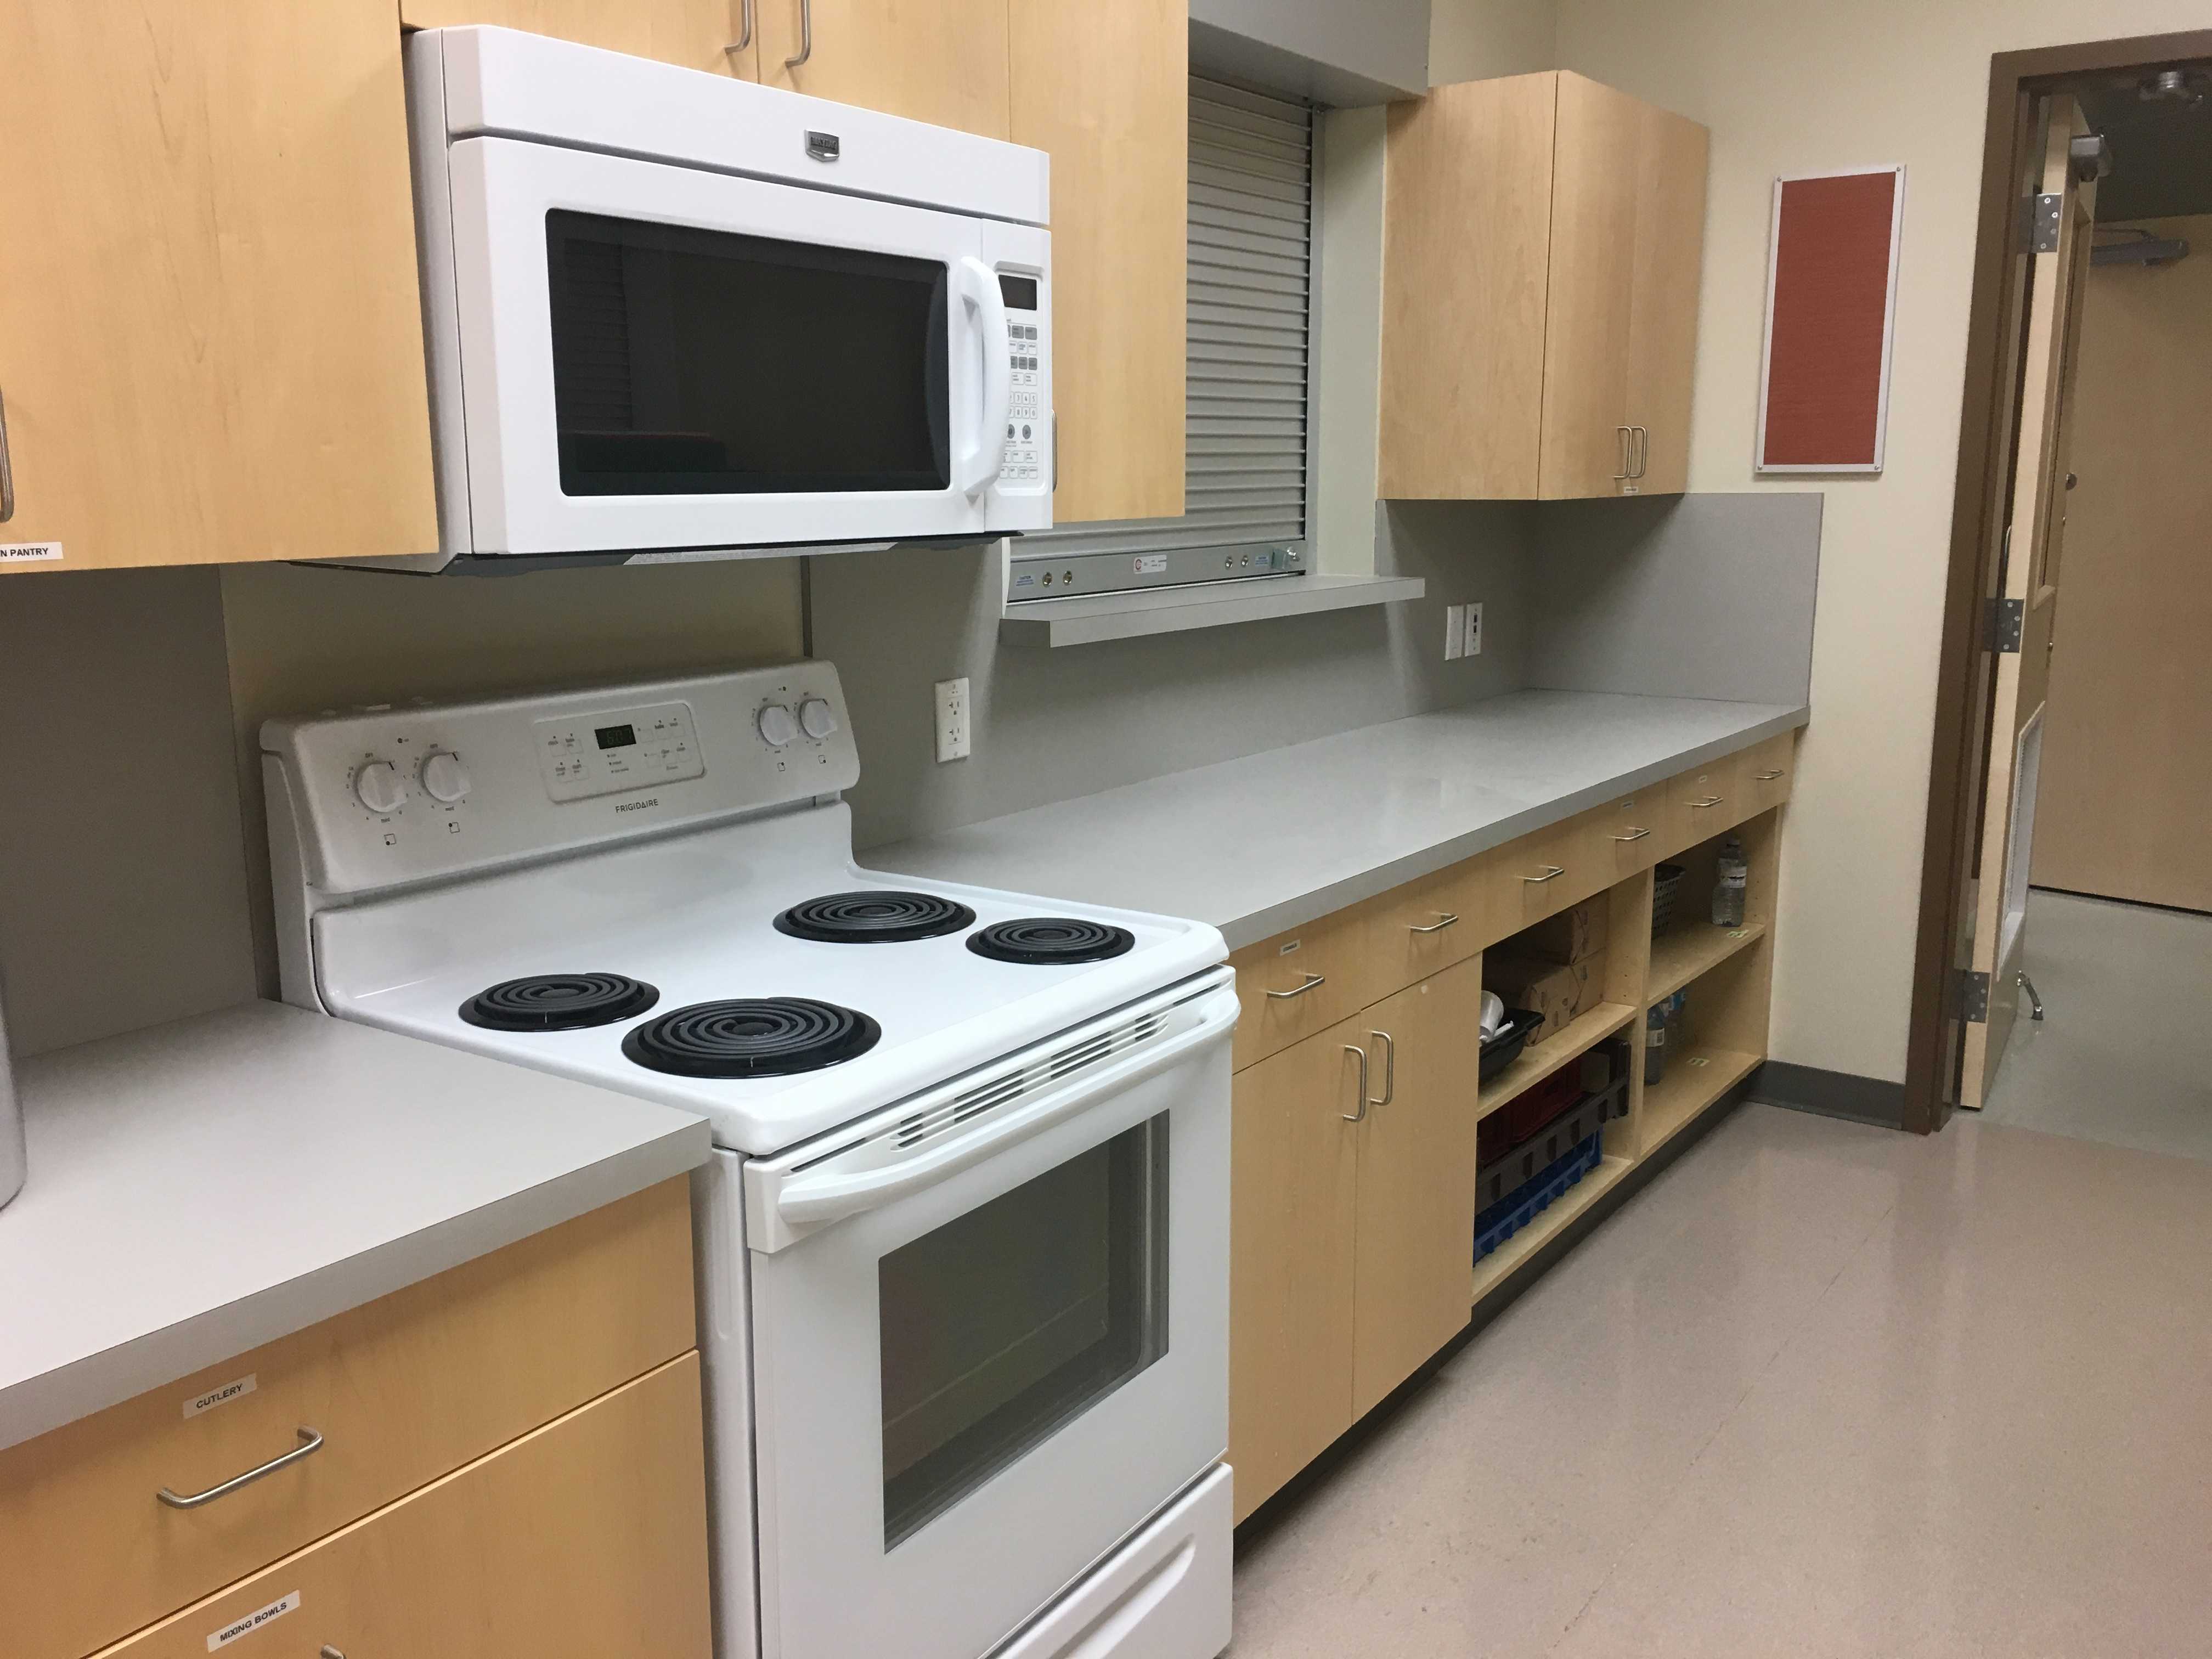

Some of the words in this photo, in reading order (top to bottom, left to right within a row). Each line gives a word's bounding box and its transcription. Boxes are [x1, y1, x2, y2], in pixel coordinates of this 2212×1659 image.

[10, 548, 49, 556] PANTRY
[615, 798, 659, 813] FRIGIDAIRE
[196, 1383, 243, 1409] CUTLERY
[219, 1620, 252, 1642] MIXING
[254, 1602, 287, 1624] BOWLS
